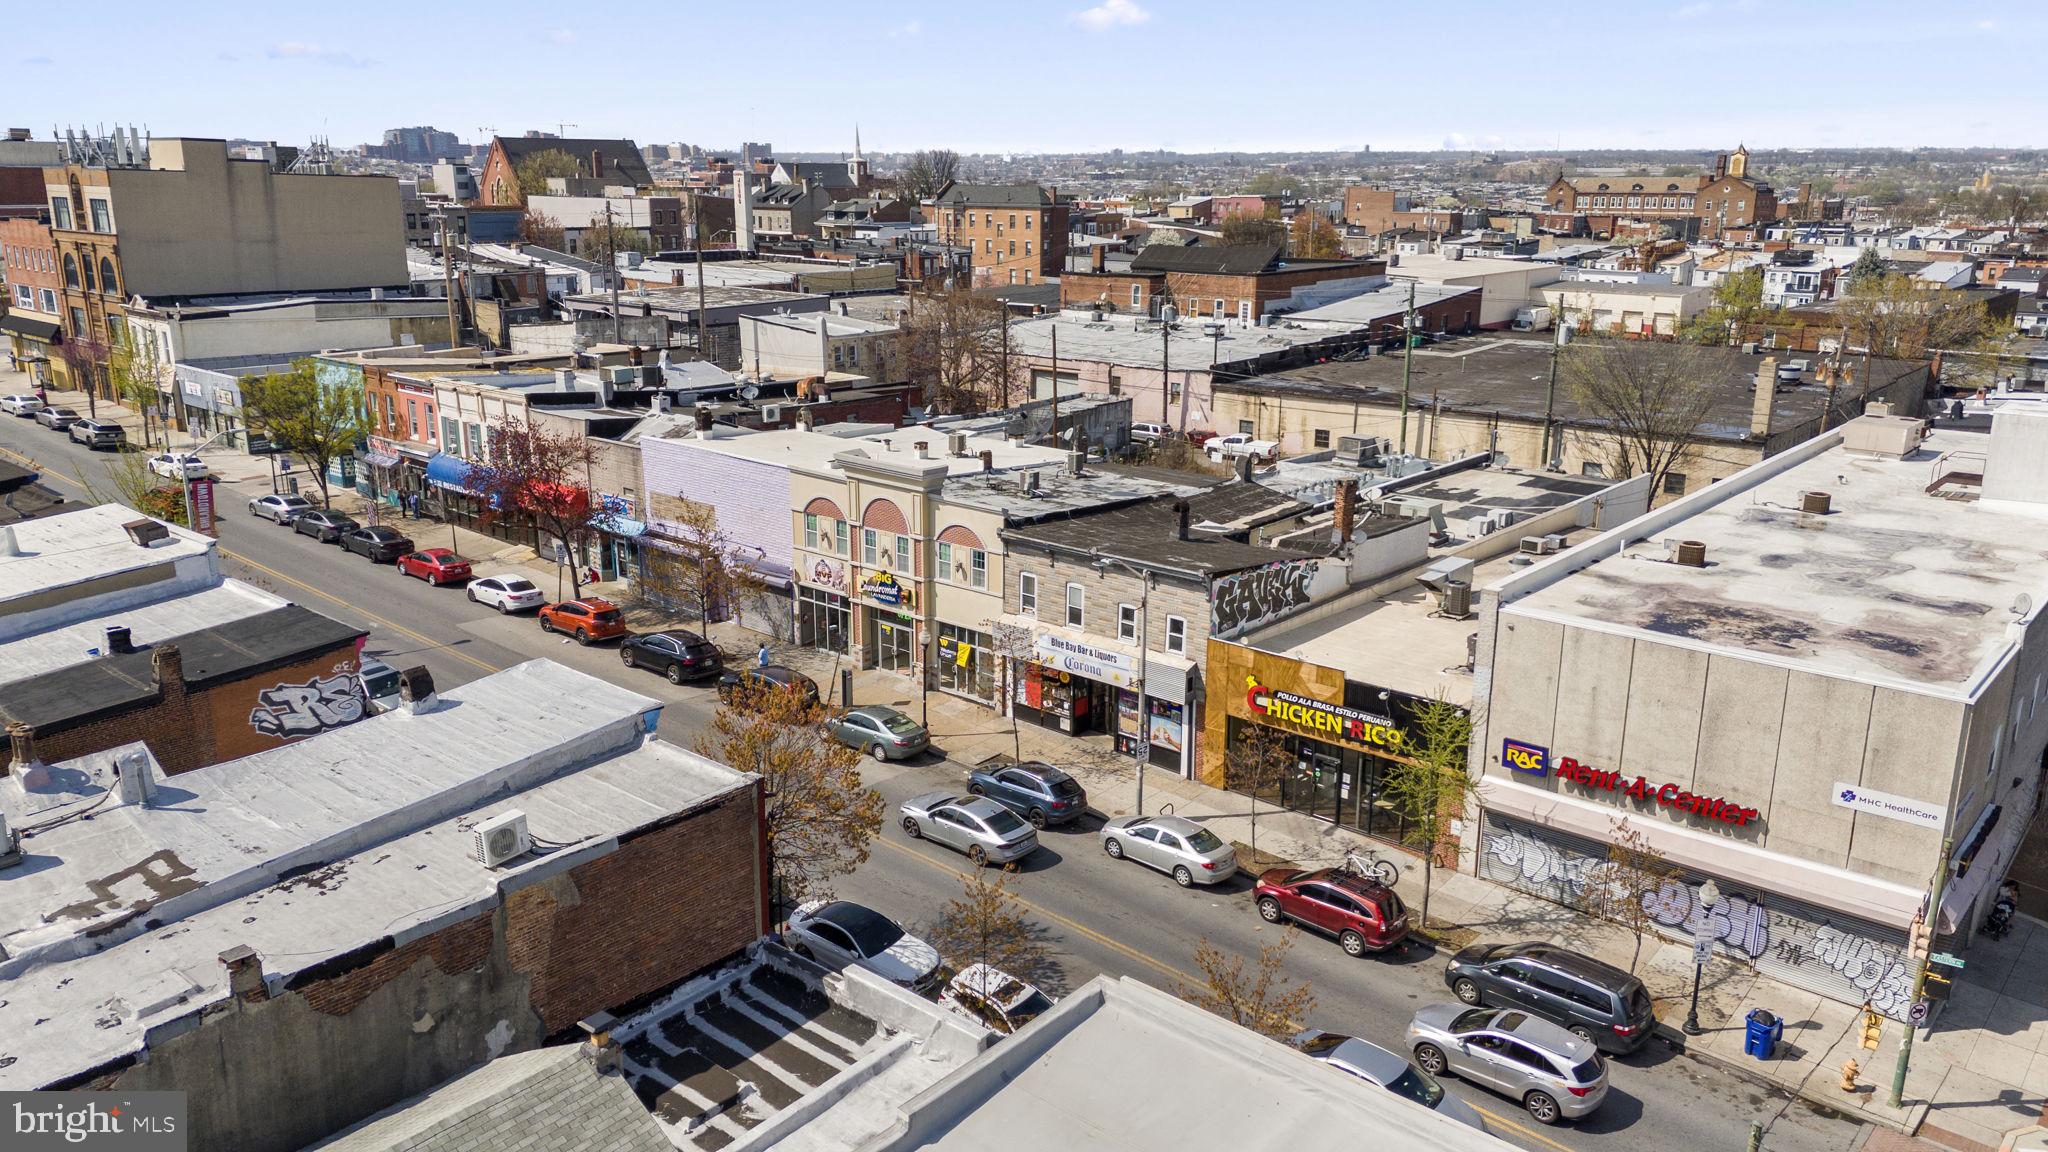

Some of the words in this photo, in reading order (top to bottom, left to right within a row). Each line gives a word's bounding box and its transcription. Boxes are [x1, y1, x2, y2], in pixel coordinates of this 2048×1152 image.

[1051, 638, 1065, 649] Blue
[1065, 641, 1076, 653] Bay
[1077, 645, 1088, 655] Bar
[1089, 649, 1093, 657] &
[1094, 650, 1117, 663] Liquors
[1064, 655, 1102, 676] Corona
[1247, 685, 1343, 734] CHICKEN
[1350, 720, 1401, 745] RICO
[1277, 691, 1299, 704] POLLO
[1312, 701, 1334, 713] BRASA
[1335, 707, 1358, 719] ESTILO
[1358, 713, 1392, 727] PERUANO
[1506, 747, 1543, 769] RAC
[1859, 796, 1882, 807] MHC
[1884, 802, 1938, 821] HealthCare
